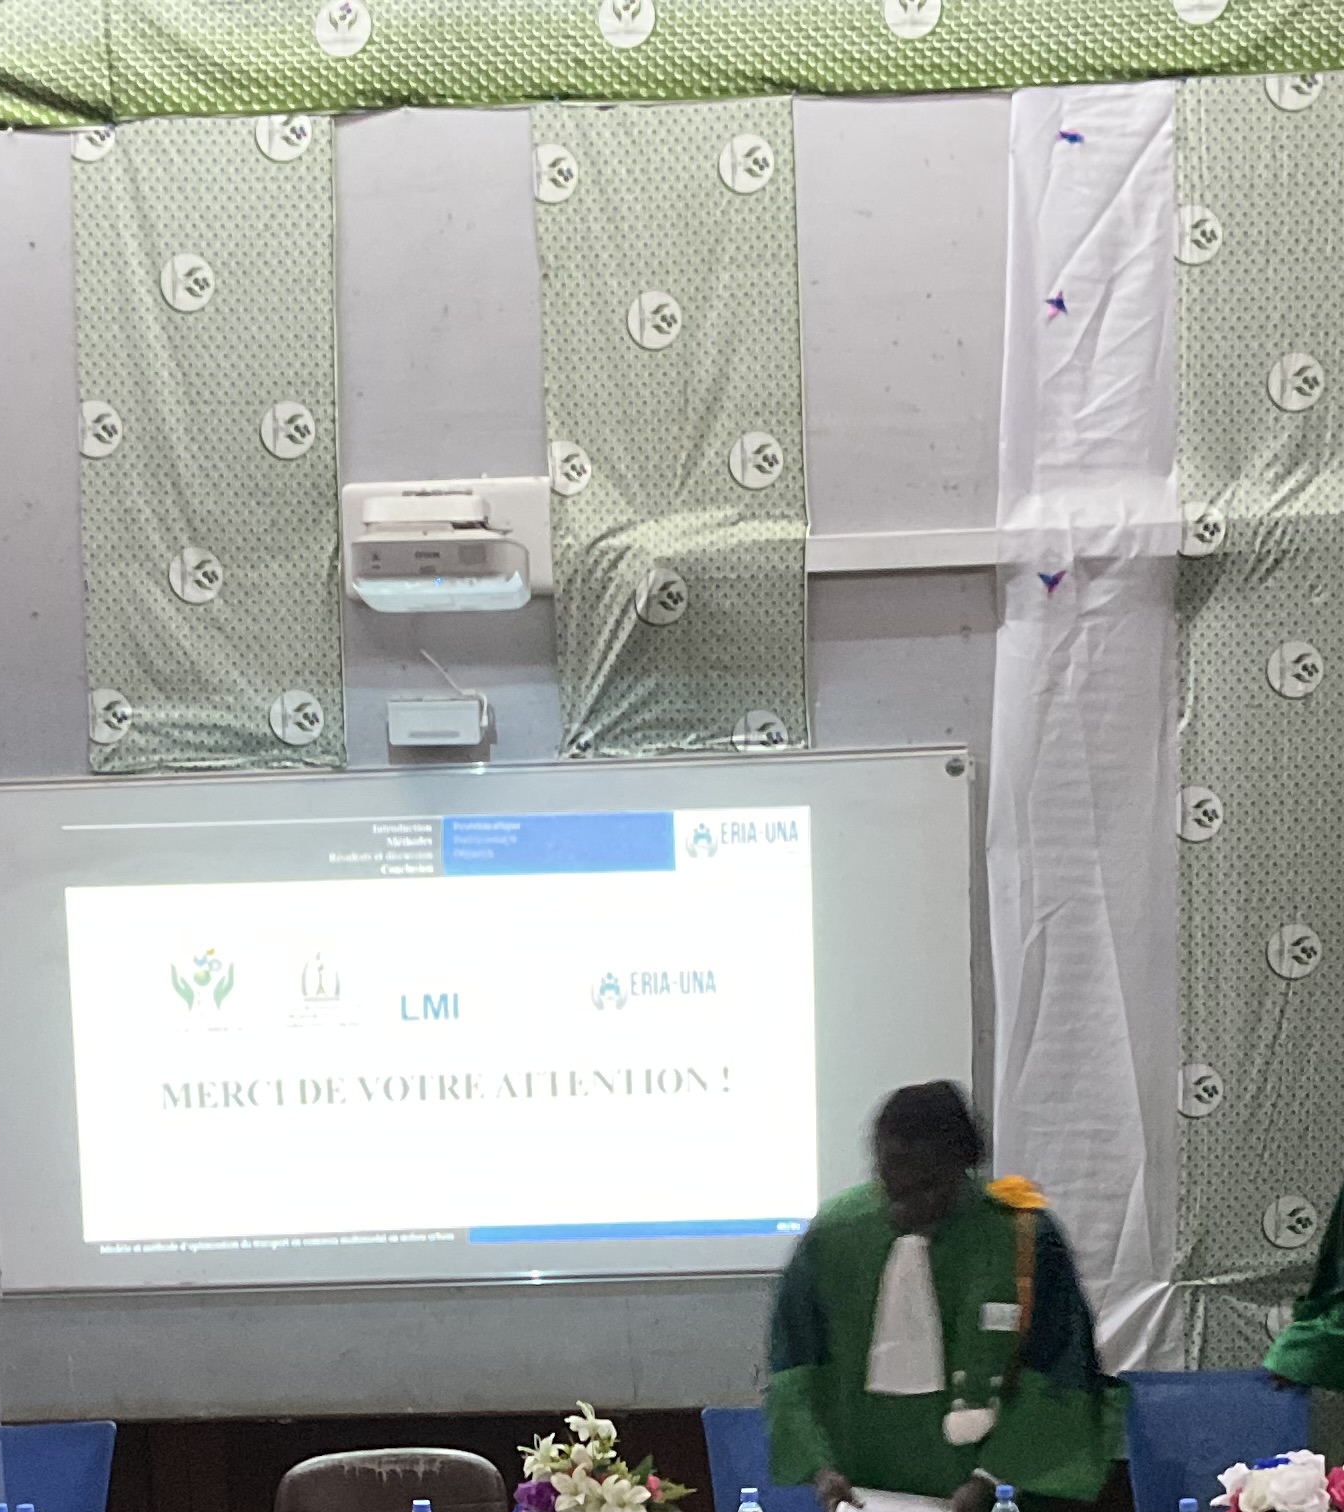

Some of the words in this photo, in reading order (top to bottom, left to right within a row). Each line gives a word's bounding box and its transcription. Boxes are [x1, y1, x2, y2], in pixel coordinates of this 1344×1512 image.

[372, 823, 433, 834] Introduction
[720, 819, 799, 845] ERIA-UNA
[630, 969, 716, 996] ERIA-UNA
[401, 992, 459, 1021] LMI
[162, 1078, 284, 1110] MERCI
[299, 1076, 347, 1105] DE
[358, 1073, 484, 1102] VOTRE
[496, 1067, 708, 1099] ATTENTION
[722, 1065, 730, 1093] !
